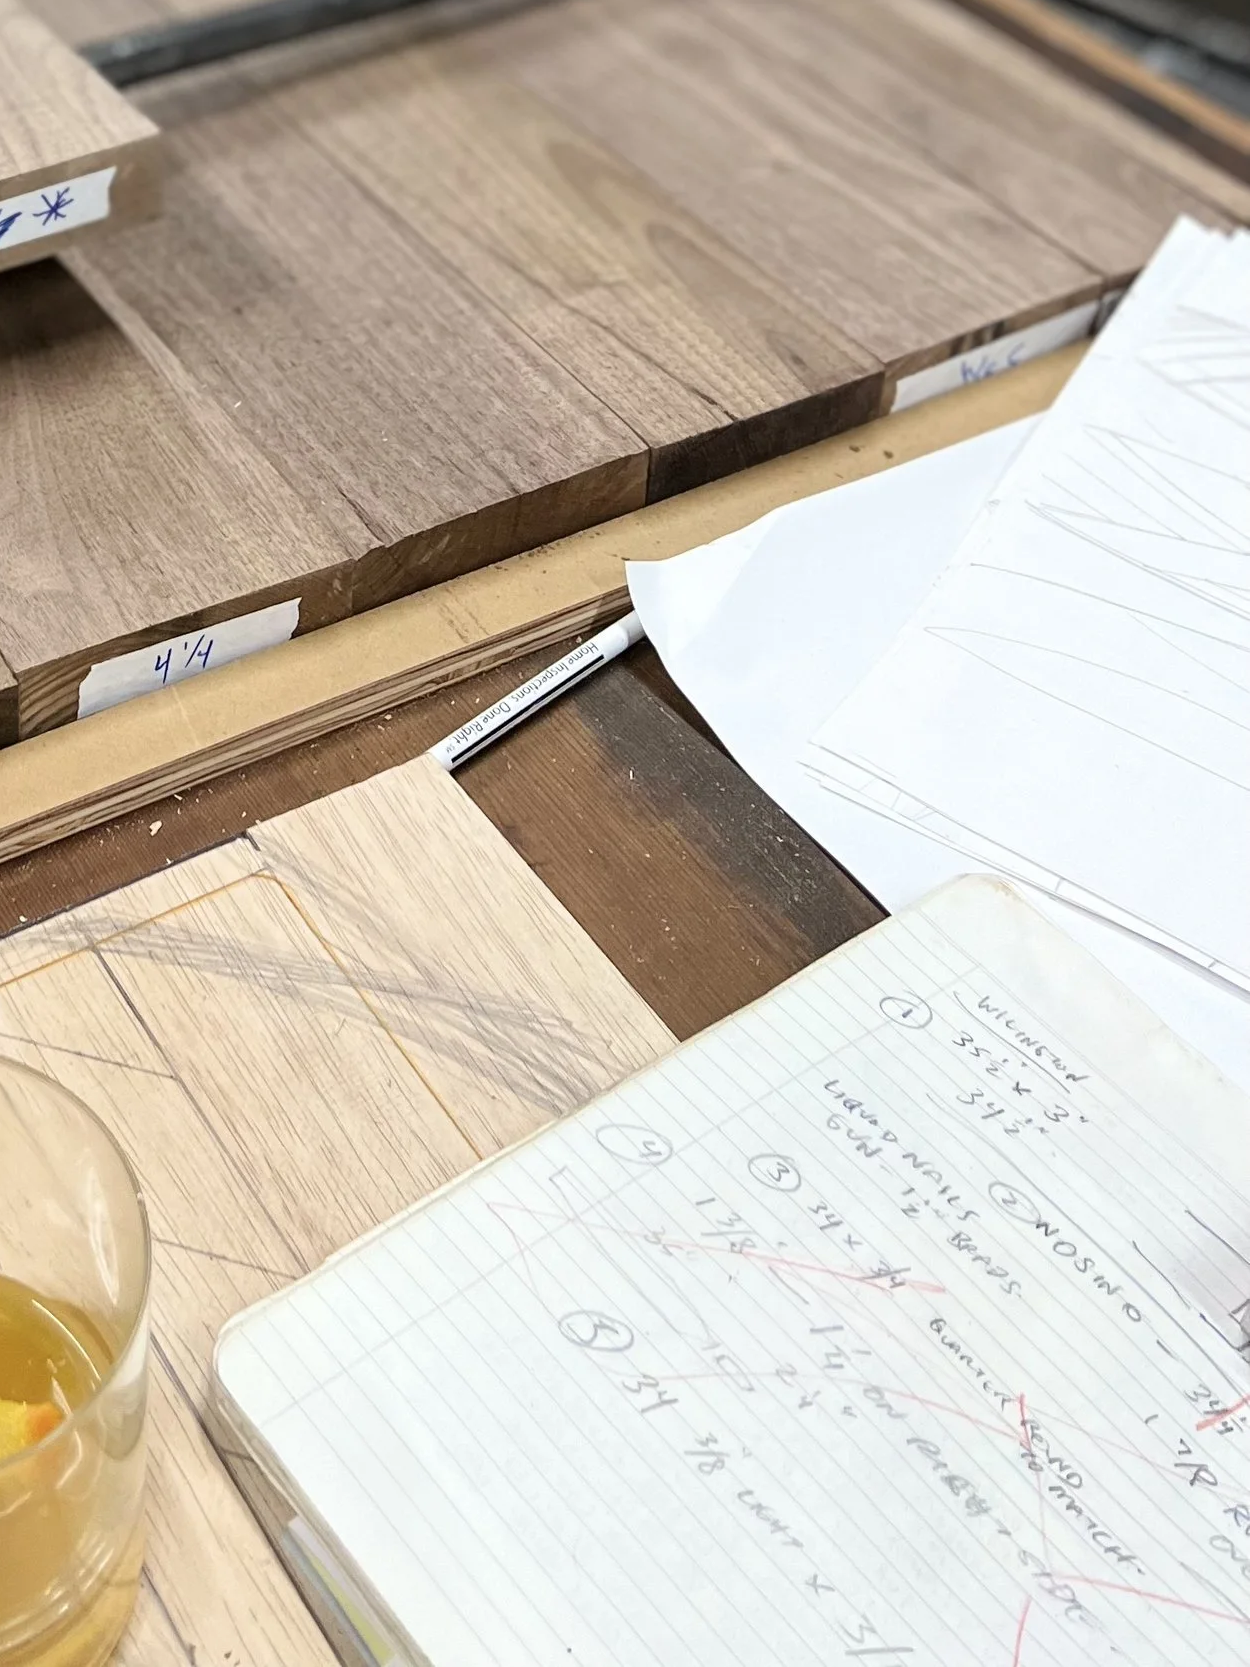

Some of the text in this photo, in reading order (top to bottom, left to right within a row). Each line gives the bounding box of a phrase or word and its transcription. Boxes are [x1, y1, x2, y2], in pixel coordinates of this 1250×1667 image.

[154, 646, 171, 684] 4
[568, 642, 599, 666] Home
[482, 701, 512, 725] Done
